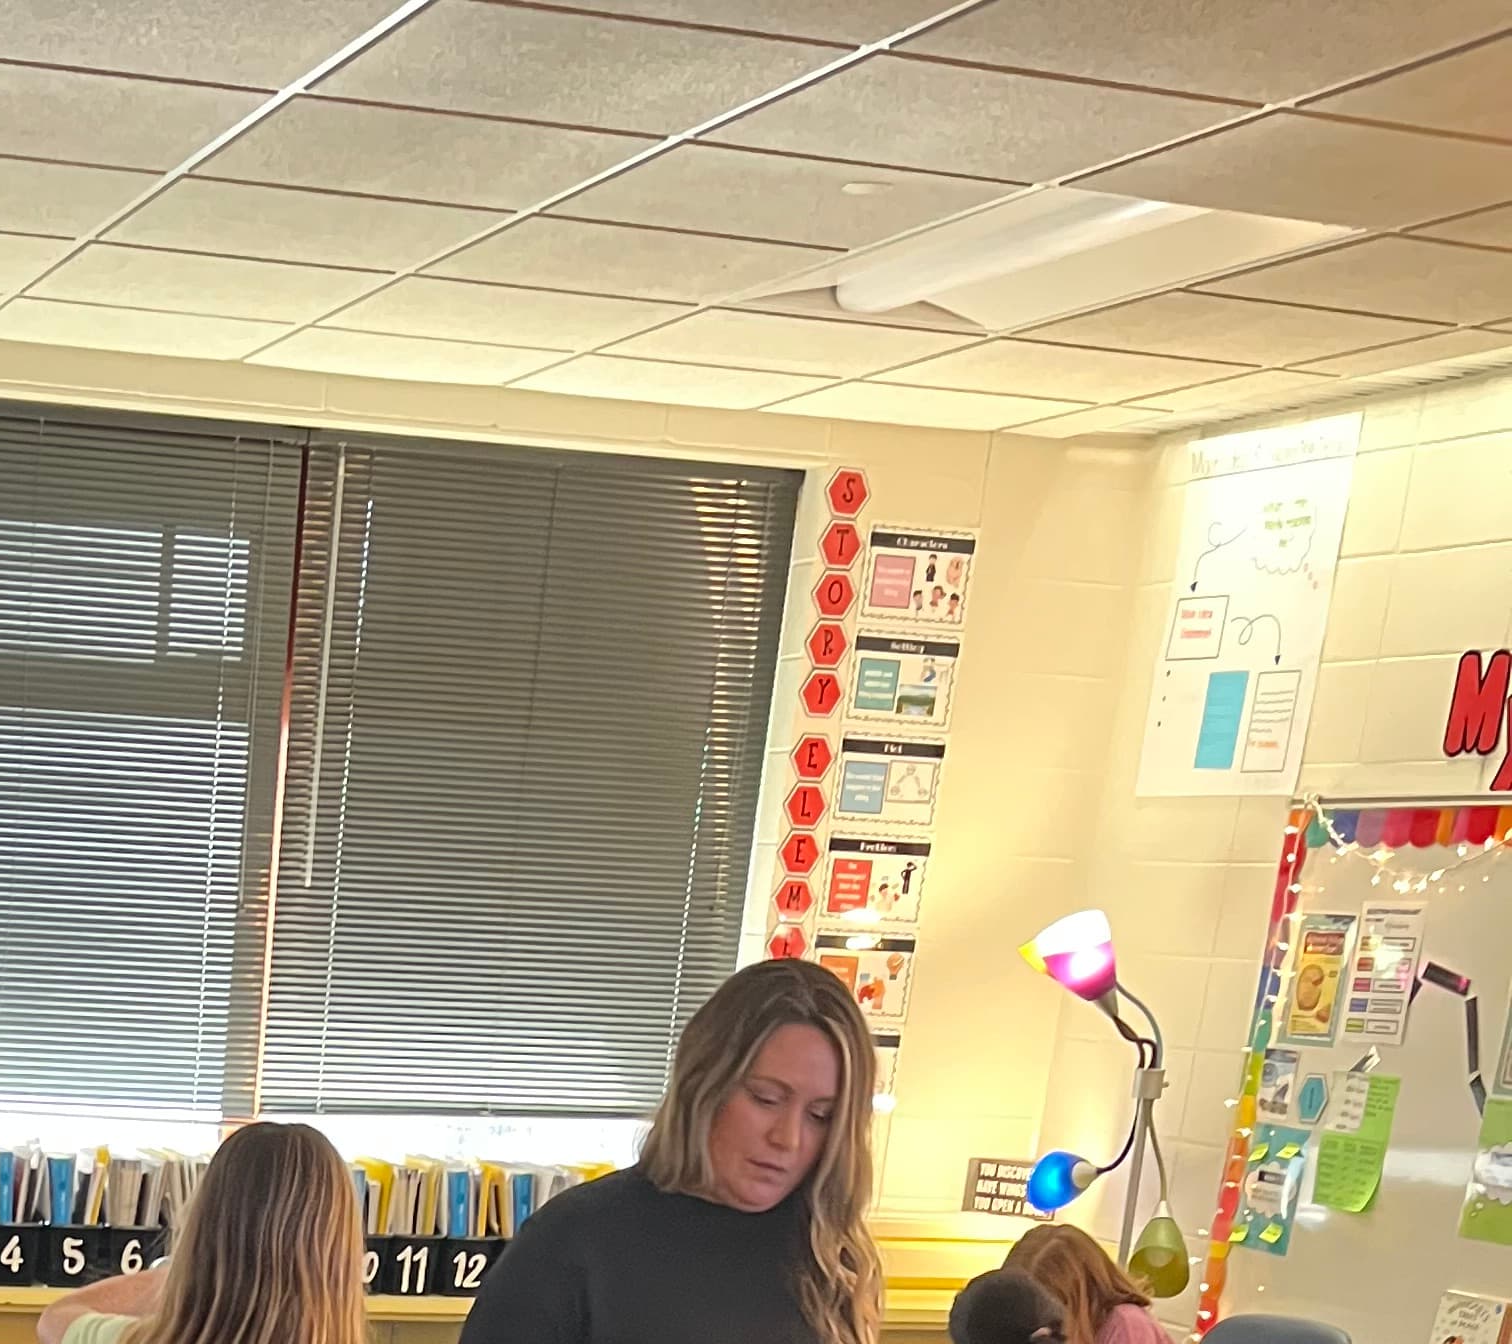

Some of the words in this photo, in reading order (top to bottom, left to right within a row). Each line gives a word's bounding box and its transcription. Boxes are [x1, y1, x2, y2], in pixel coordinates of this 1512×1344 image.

[0, 1234, 24, 1273] 4
[62, 1236, 86, 1275] 5
[120, 1239, 143, 1275] 6
[396, 1245, 429, 1294] 11
[453, 1251, 488, 1288] 12
